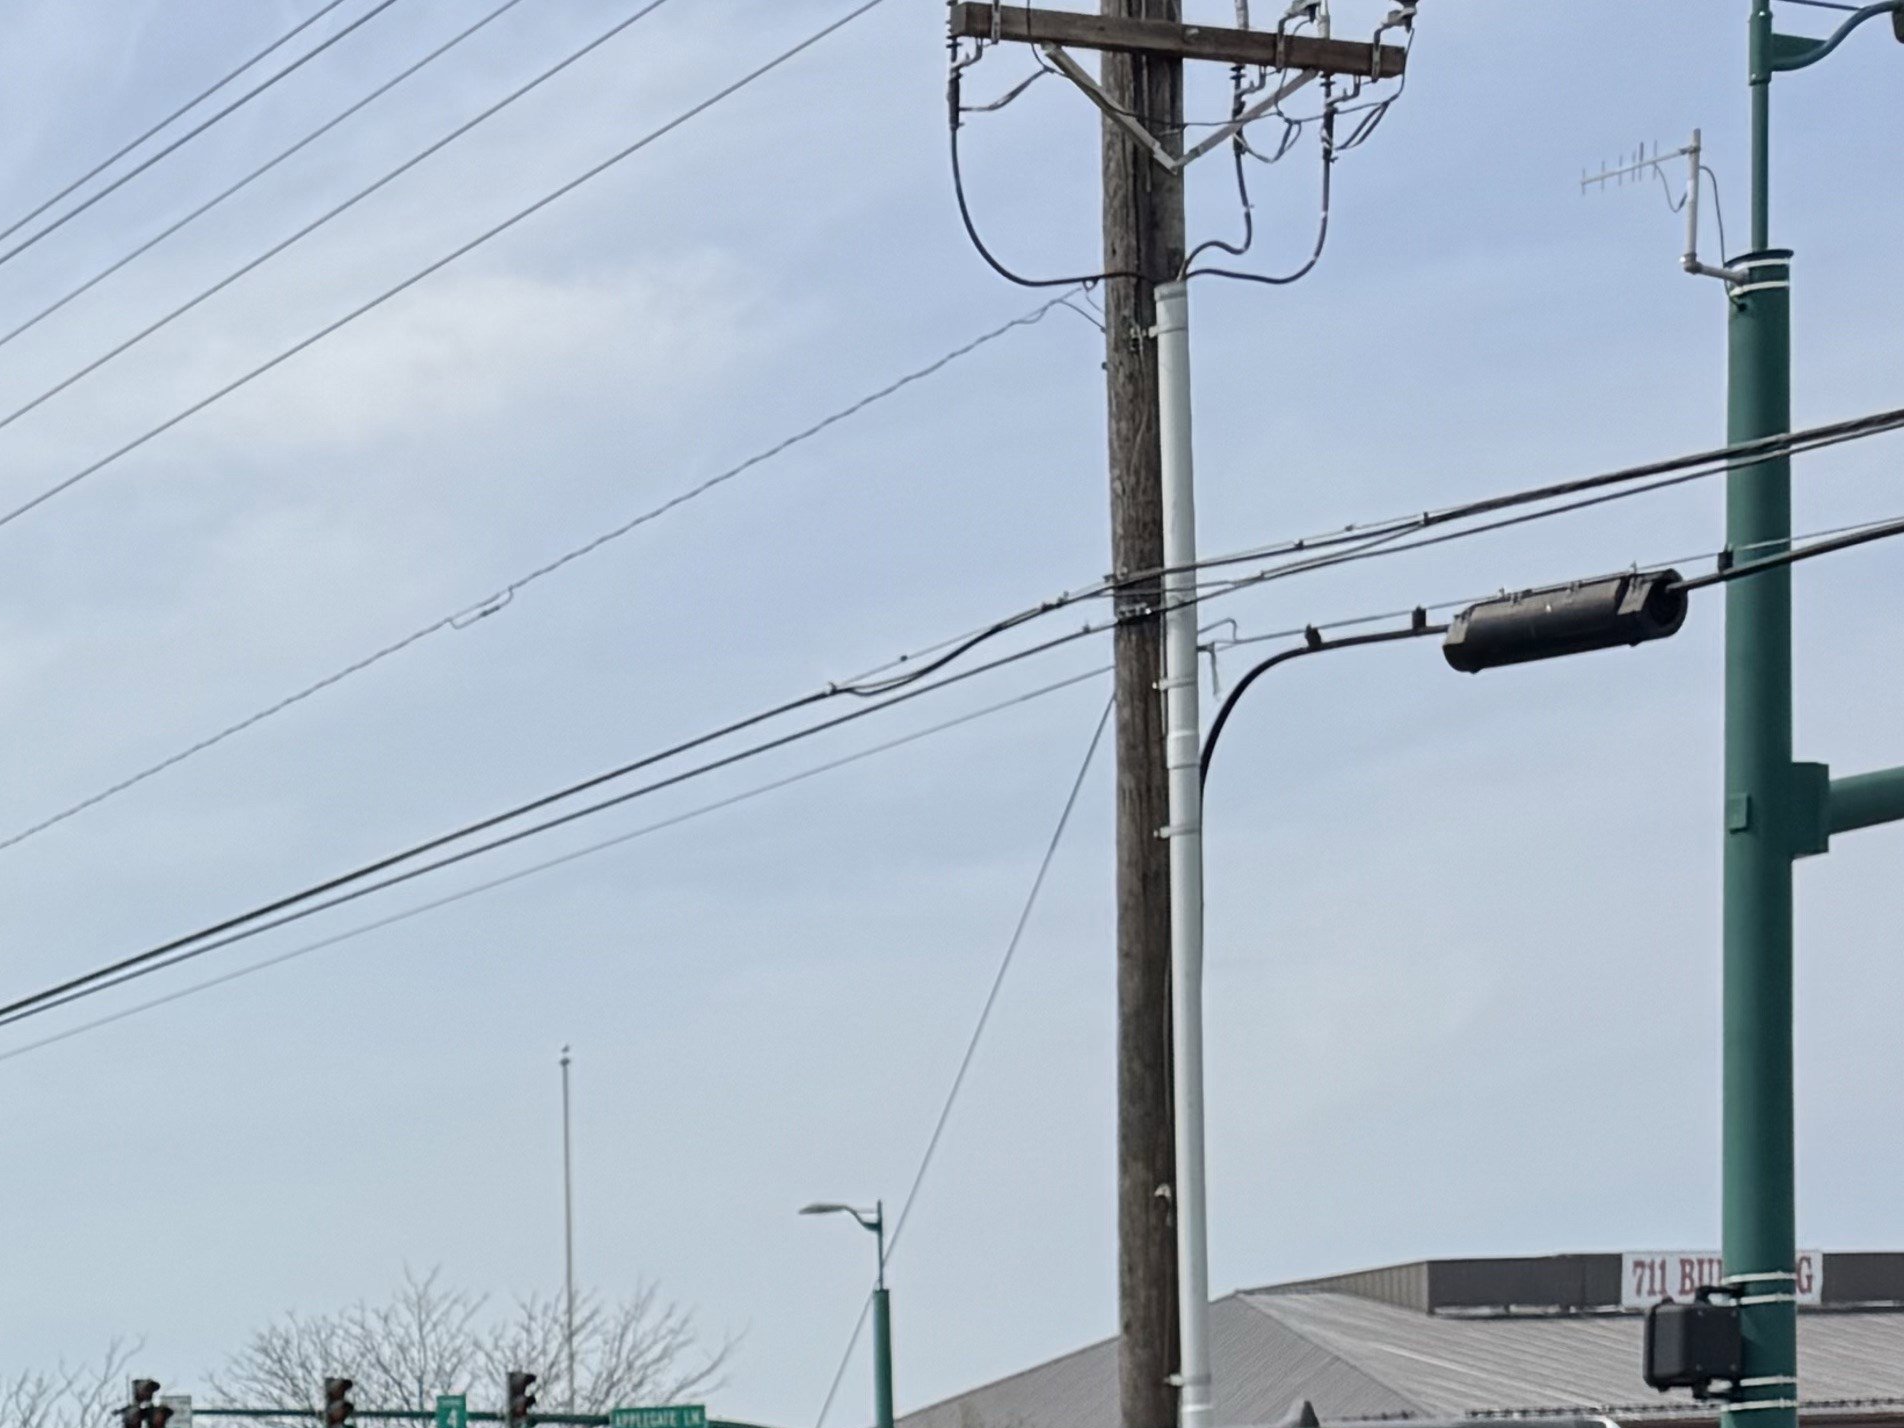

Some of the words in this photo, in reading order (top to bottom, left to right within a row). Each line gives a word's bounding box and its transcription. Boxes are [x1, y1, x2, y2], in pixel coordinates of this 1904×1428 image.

[1632, 1258, 1667, 1297] 711
[616, 1410, 677, 1428] APPLEGATE
[683, 1408, 702, 1425] LN
